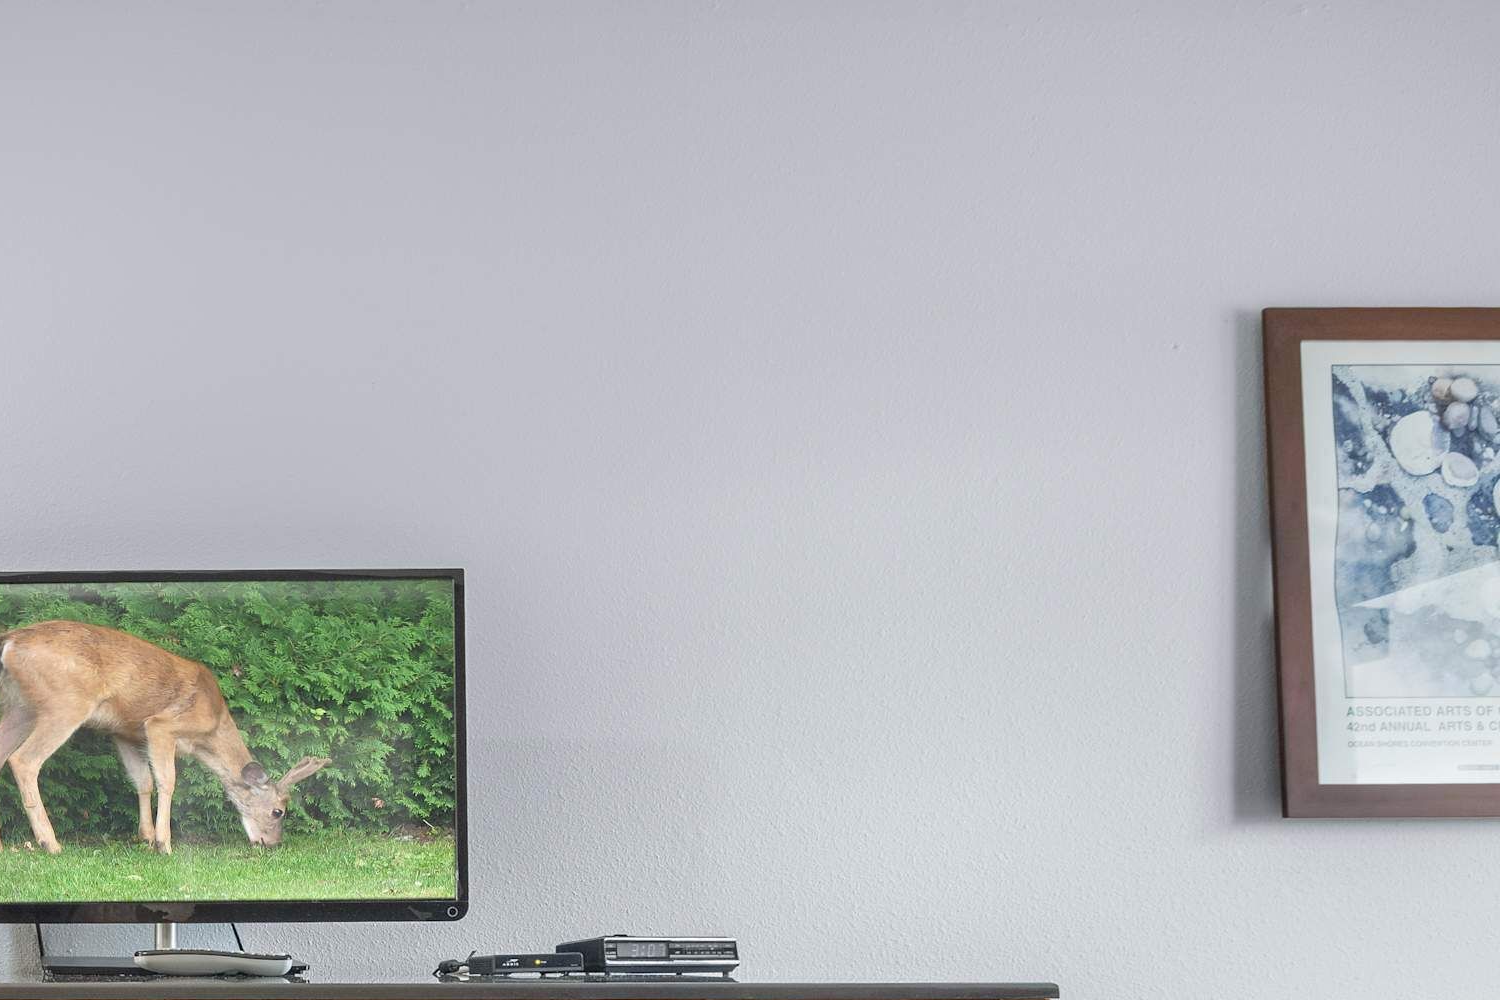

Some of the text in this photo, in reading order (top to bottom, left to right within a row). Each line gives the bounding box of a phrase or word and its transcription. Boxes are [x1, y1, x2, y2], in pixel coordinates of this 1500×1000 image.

[1346, 705, 1432, 717] ASSOCIATED
[1436, 705, 1472, 717] ARTS
[1476, 705, 1494, 717] OF
[1346, 721, 1376, 732] 42nd
[1379, 721, 1432, 732] ANNUAL
[1438, 720, 1473, 731] ARTS
[1476, 720, 1485, 731] &
